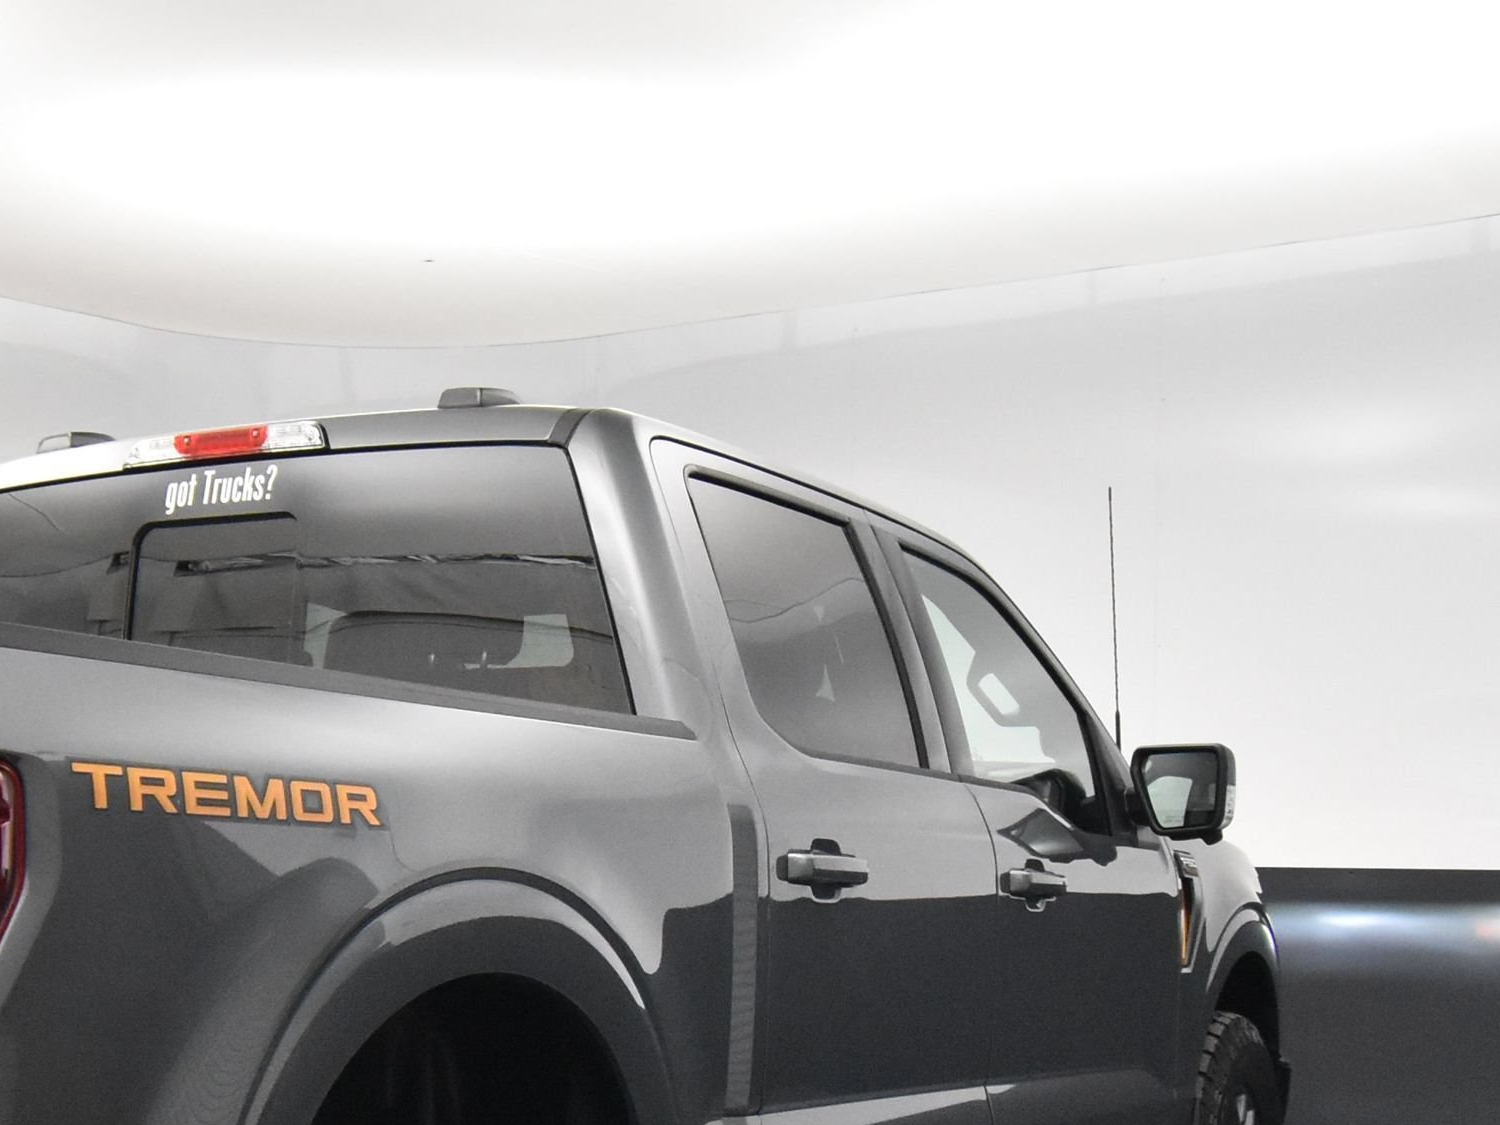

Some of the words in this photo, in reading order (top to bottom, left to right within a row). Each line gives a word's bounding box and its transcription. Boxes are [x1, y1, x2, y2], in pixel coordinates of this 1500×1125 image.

[165, 473, 197, 515] got
[202, 464, 279, 505] Trucks?
[70, 761, 383, 827] TREMOR
